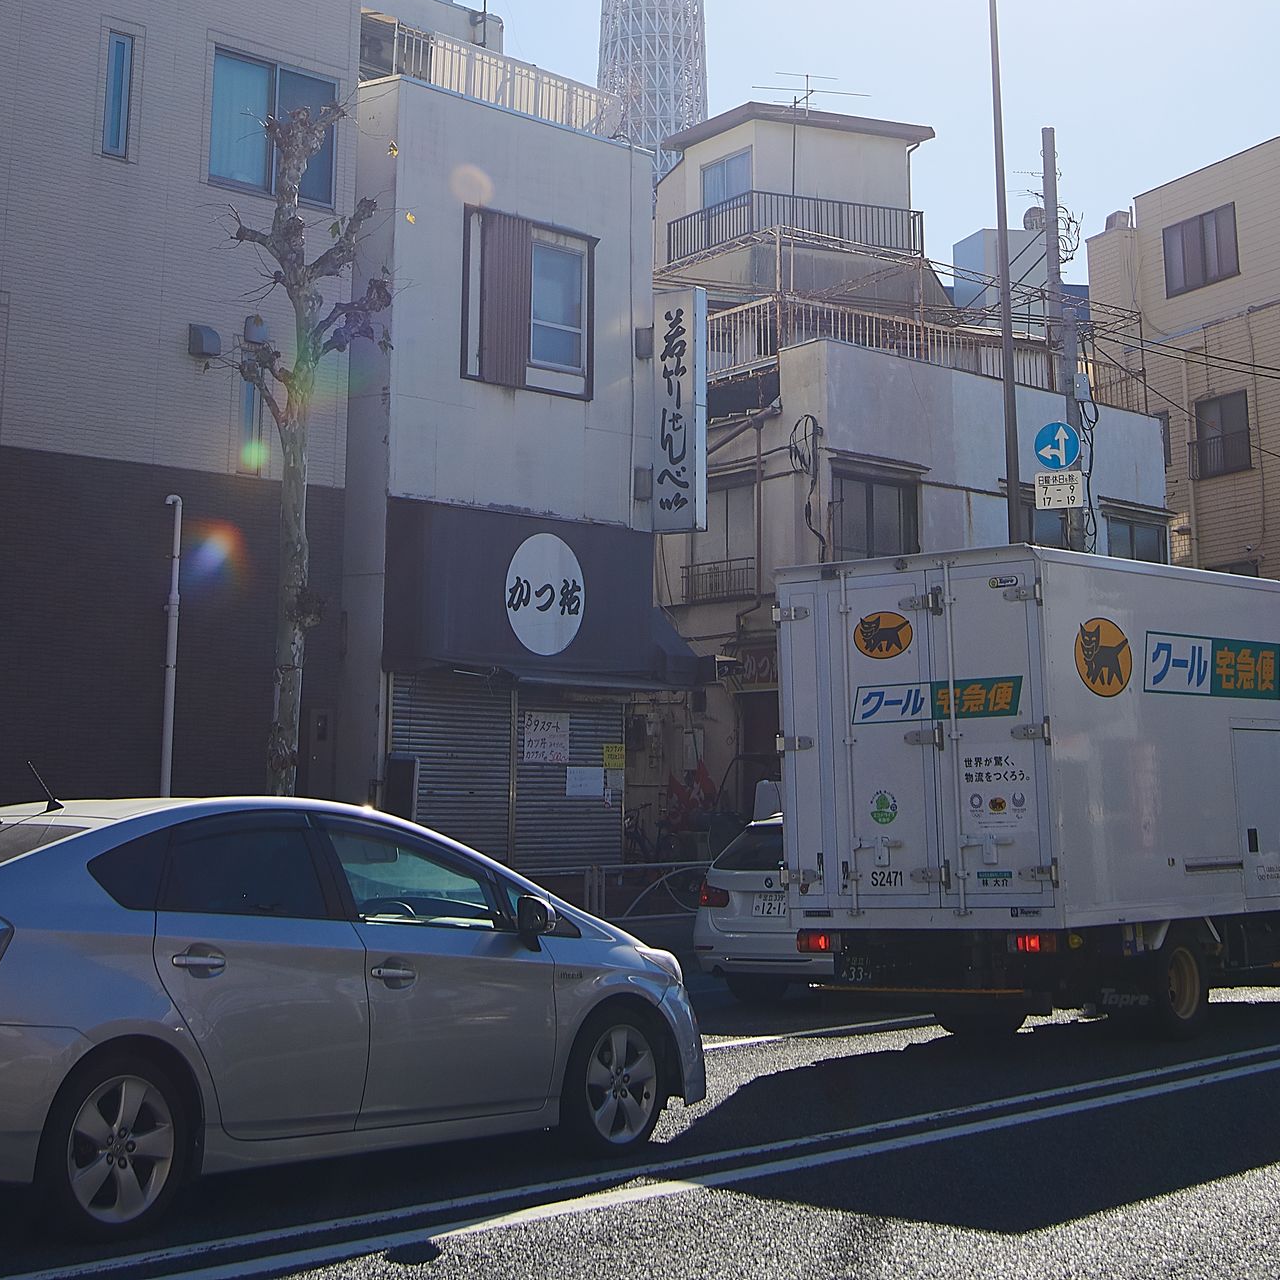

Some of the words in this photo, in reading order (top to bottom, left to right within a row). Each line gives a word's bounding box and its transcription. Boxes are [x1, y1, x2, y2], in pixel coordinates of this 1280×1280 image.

[1042, 486, 1049, 496] 7
[1069, 485, 1075, 494] 9
[1042, 497, 1052, 506] 17
[1066, 495, 1076, 505] 19
[743, 654, 777, 683] かつ
[964, 755, 1015, 768] 世界が驚く、
[964, 770, 1030, 783] 物流をつくろう。
[871, 871, 903, 887] S2471
[1101, 987, 1150, 1008] Topre
